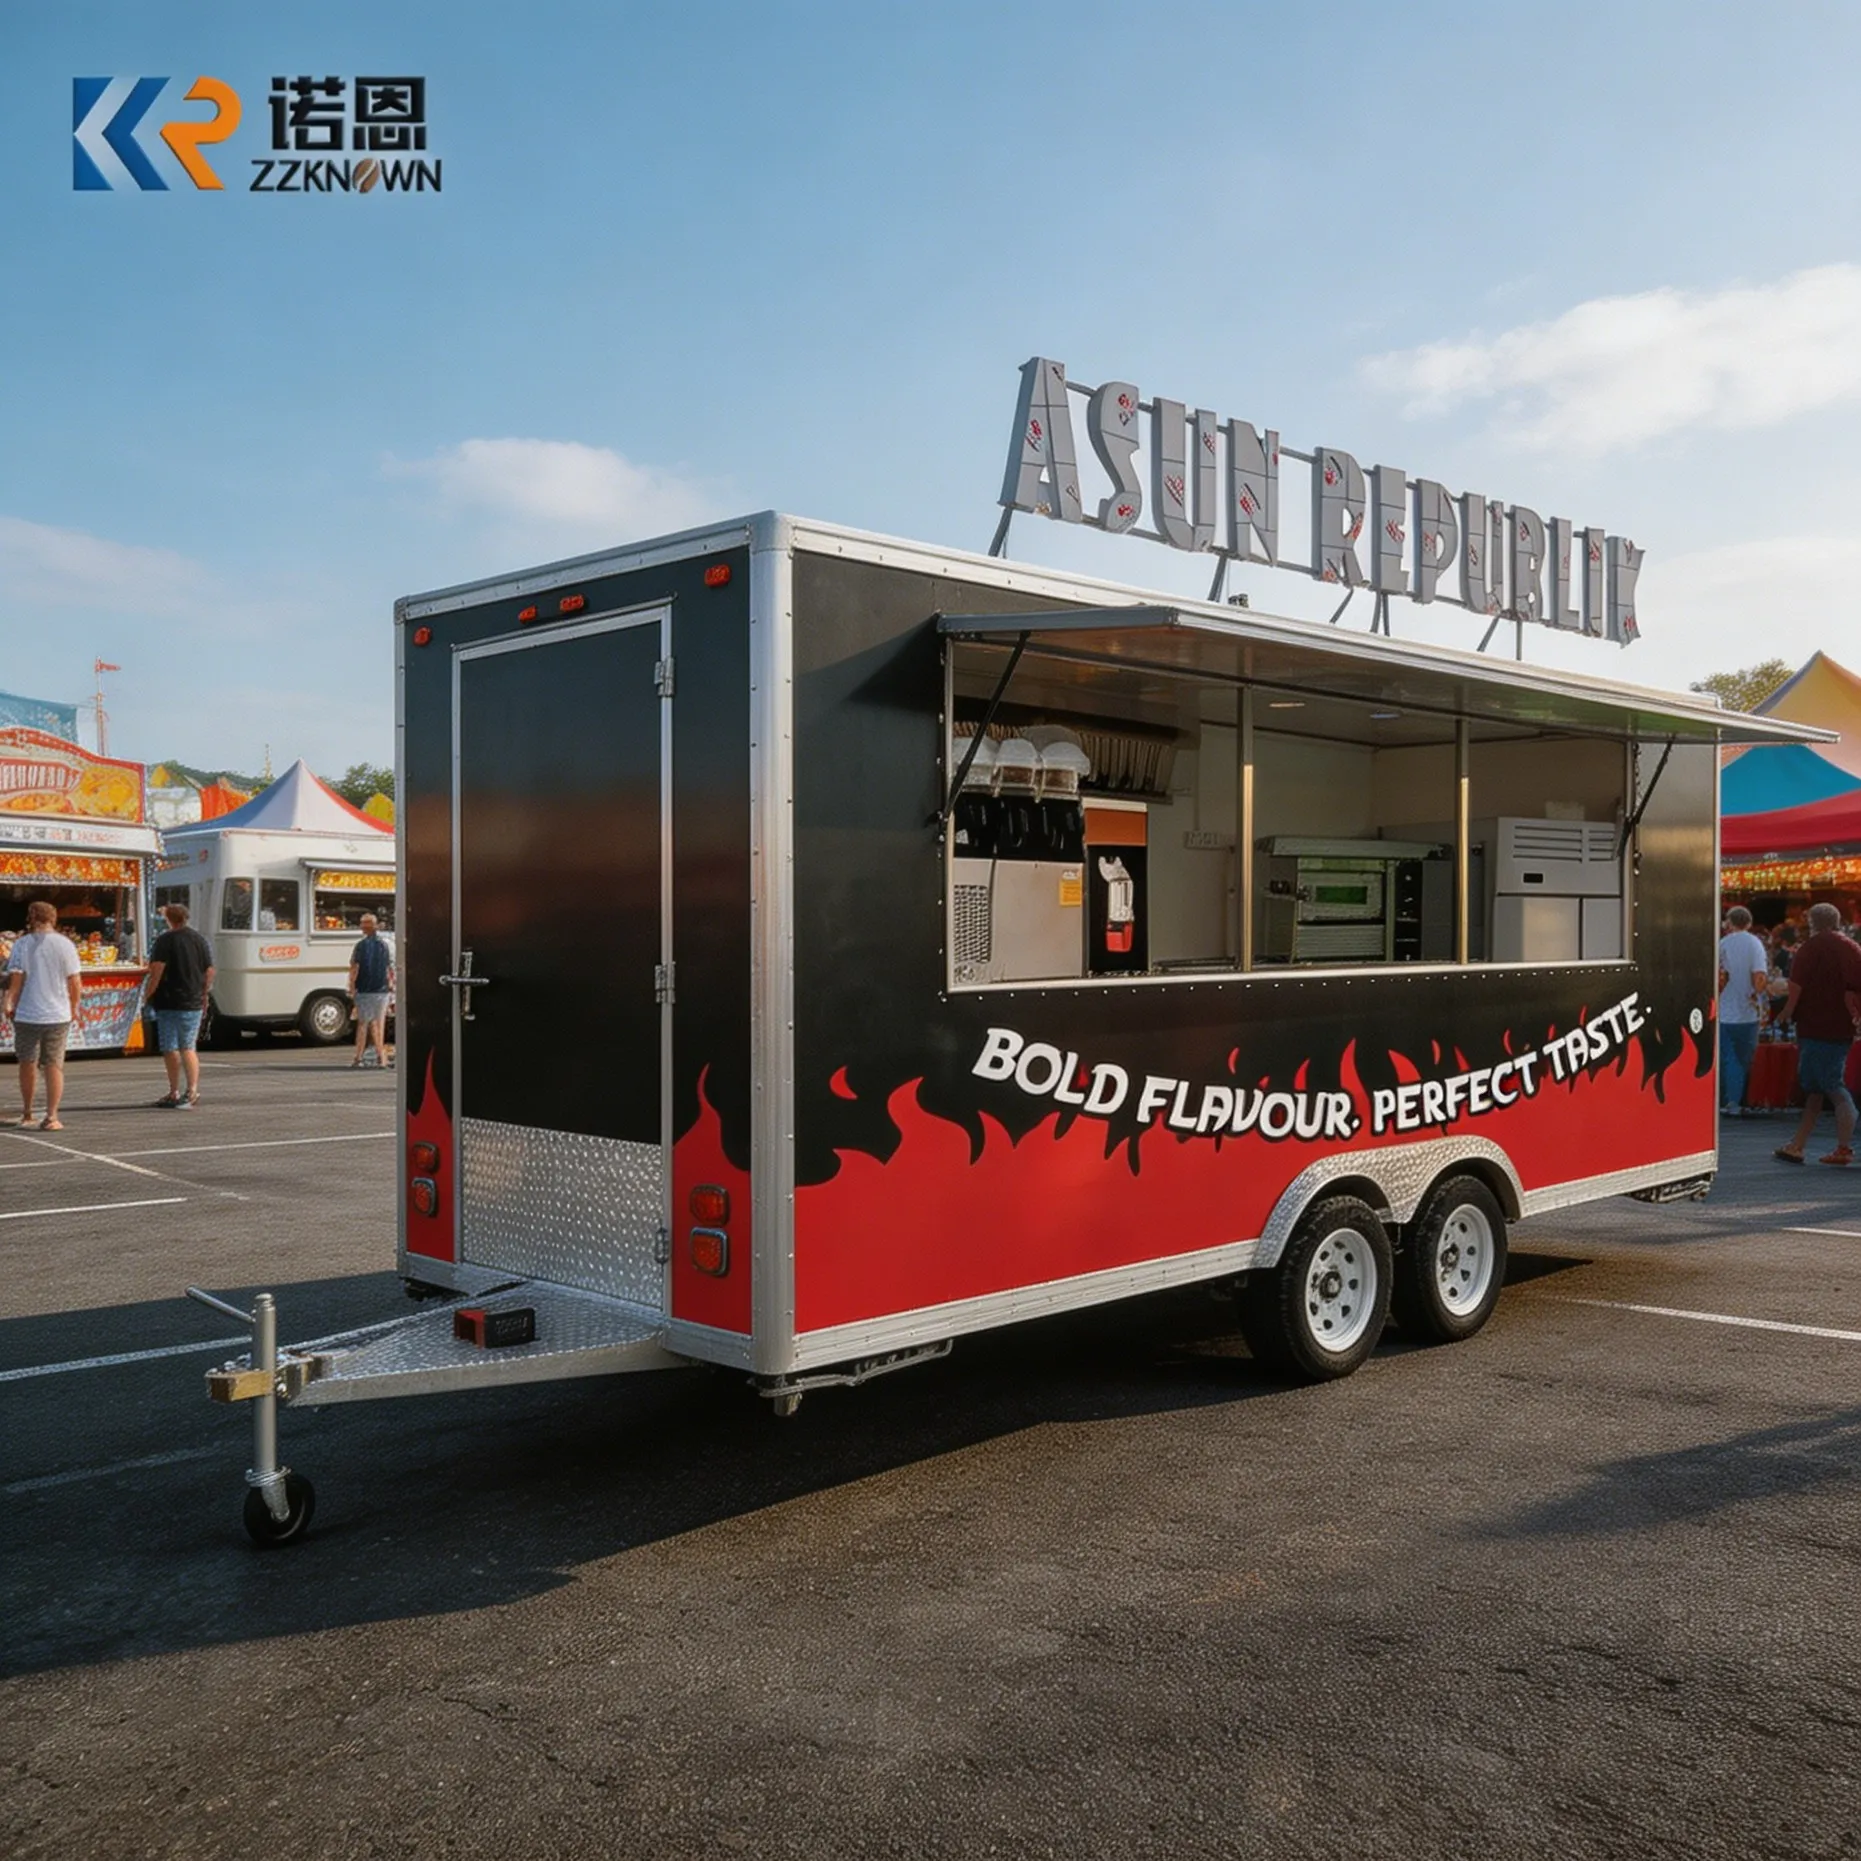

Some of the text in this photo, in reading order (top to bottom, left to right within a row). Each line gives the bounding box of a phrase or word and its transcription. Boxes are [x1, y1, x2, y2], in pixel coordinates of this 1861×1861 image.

[997, 356, 1280, 567] ASUN
[971, 991, 1652, 1139] BOLD FLAVOUR. PERFECT TASTE.
